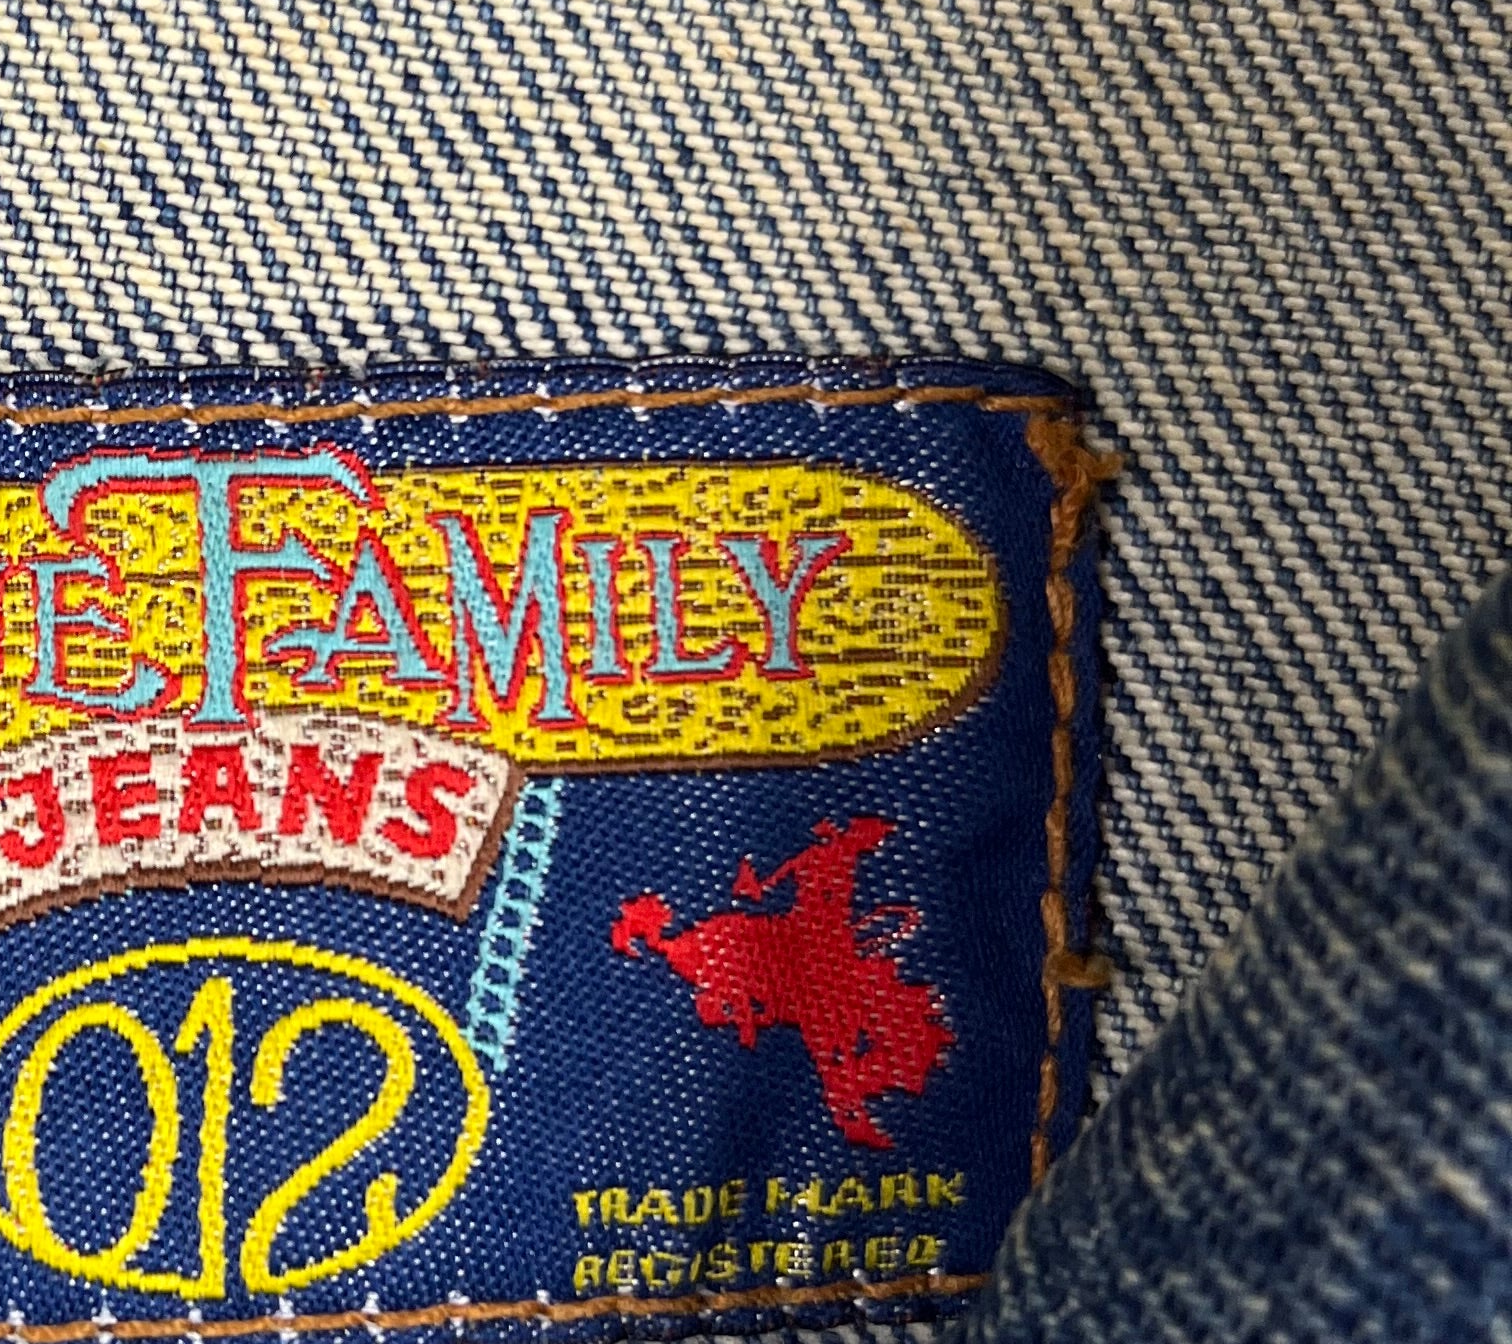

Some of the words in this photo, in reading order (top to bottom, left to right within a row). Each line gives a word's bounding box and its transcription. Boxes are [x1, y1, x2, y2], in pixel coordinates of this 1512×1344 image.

[3, 978, 425, 1299] 012
[572, 1177, 748, 1229] TRADE
[766, 1171, 967, 1217] MARK
[572, 1233, 944, 1293] REGISTERED
